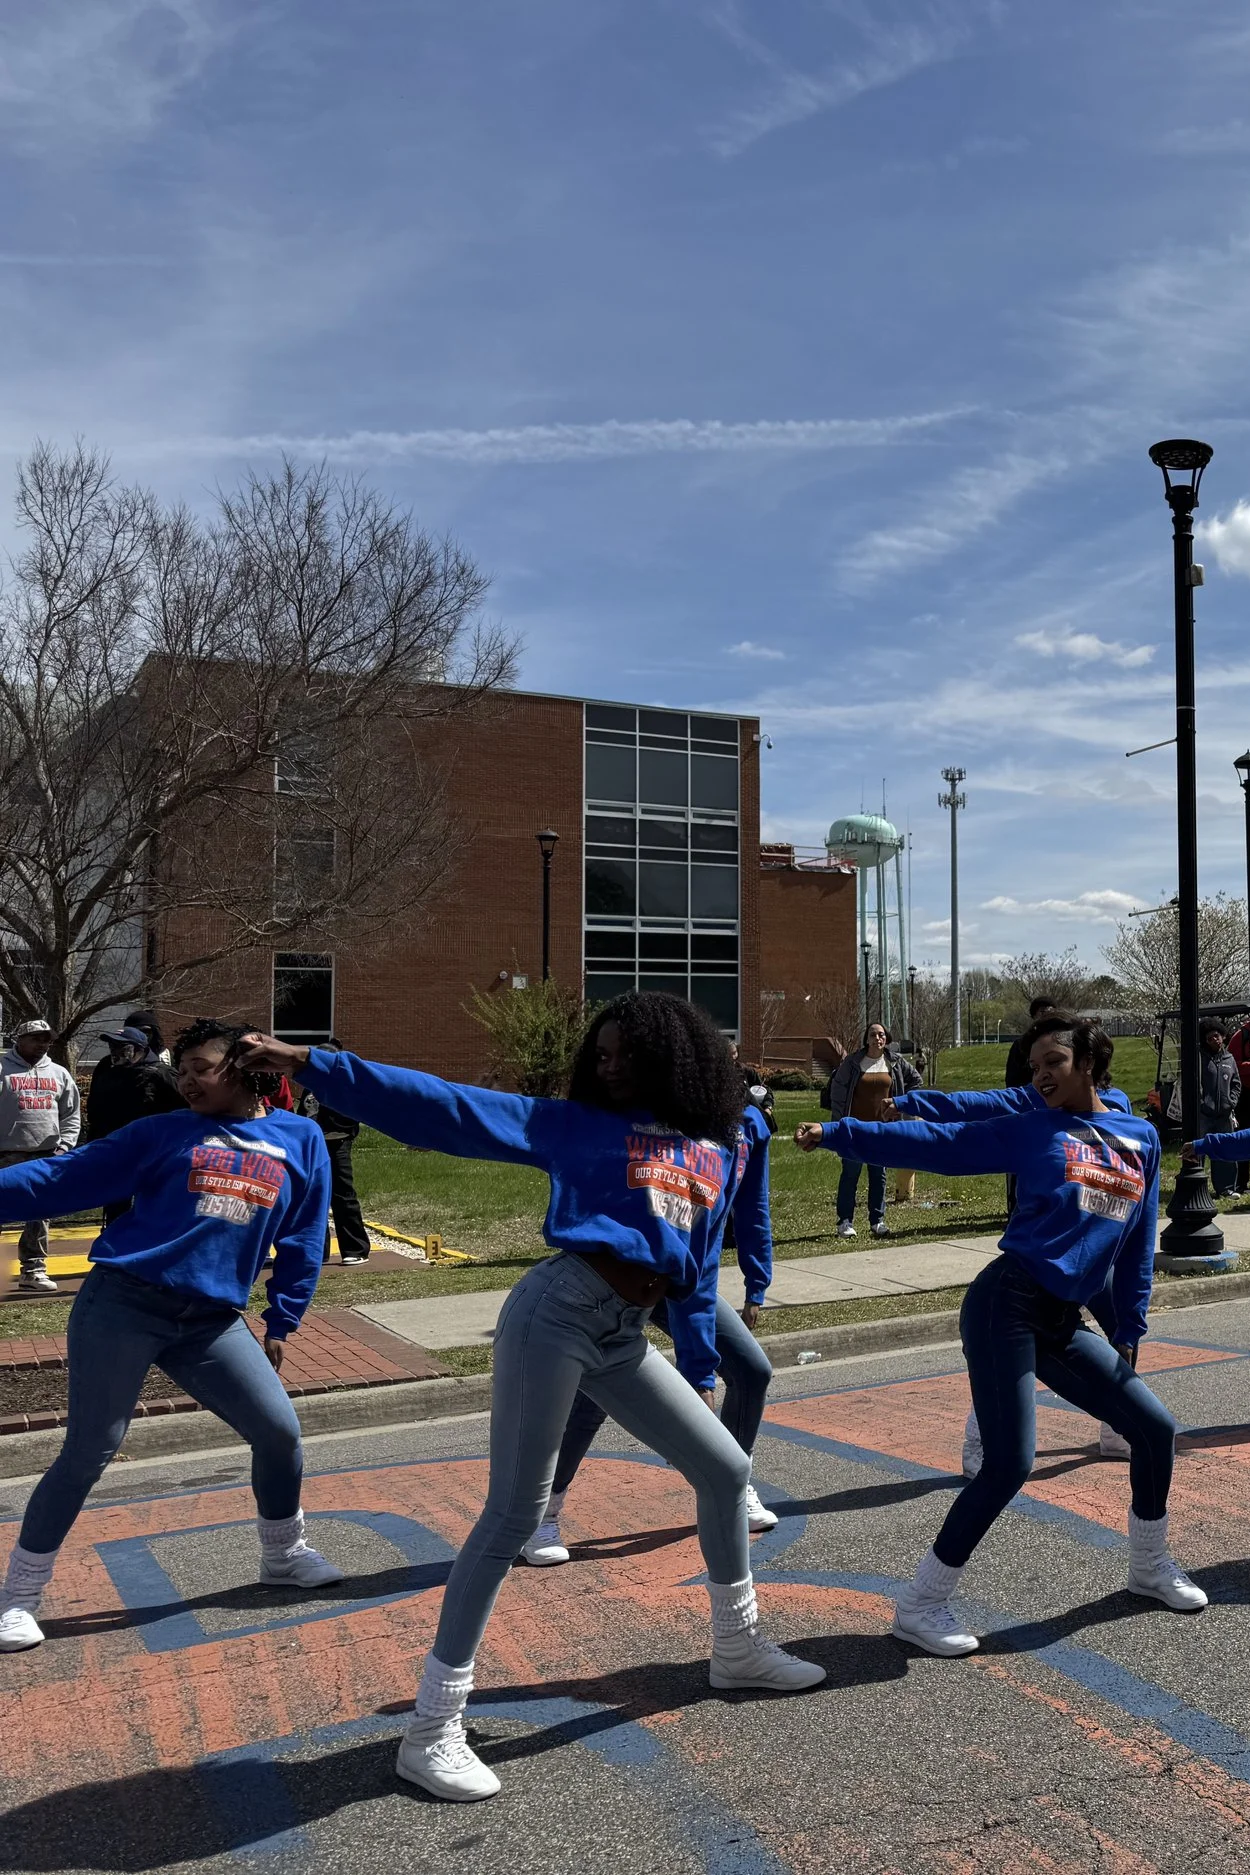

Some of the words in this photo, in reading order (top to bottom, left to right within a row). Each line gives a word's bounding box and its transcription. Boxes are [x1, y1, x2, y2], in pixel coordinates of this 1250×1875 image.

[18, 1095, 53, 1110] STATE
[207, 1176, 231, 1189] STYLE
[231, 1180, 251, 1193] ISN'T
[635, 1167, 652, 1179] OUR
[653, 1168, 677, 1185] STYLE
